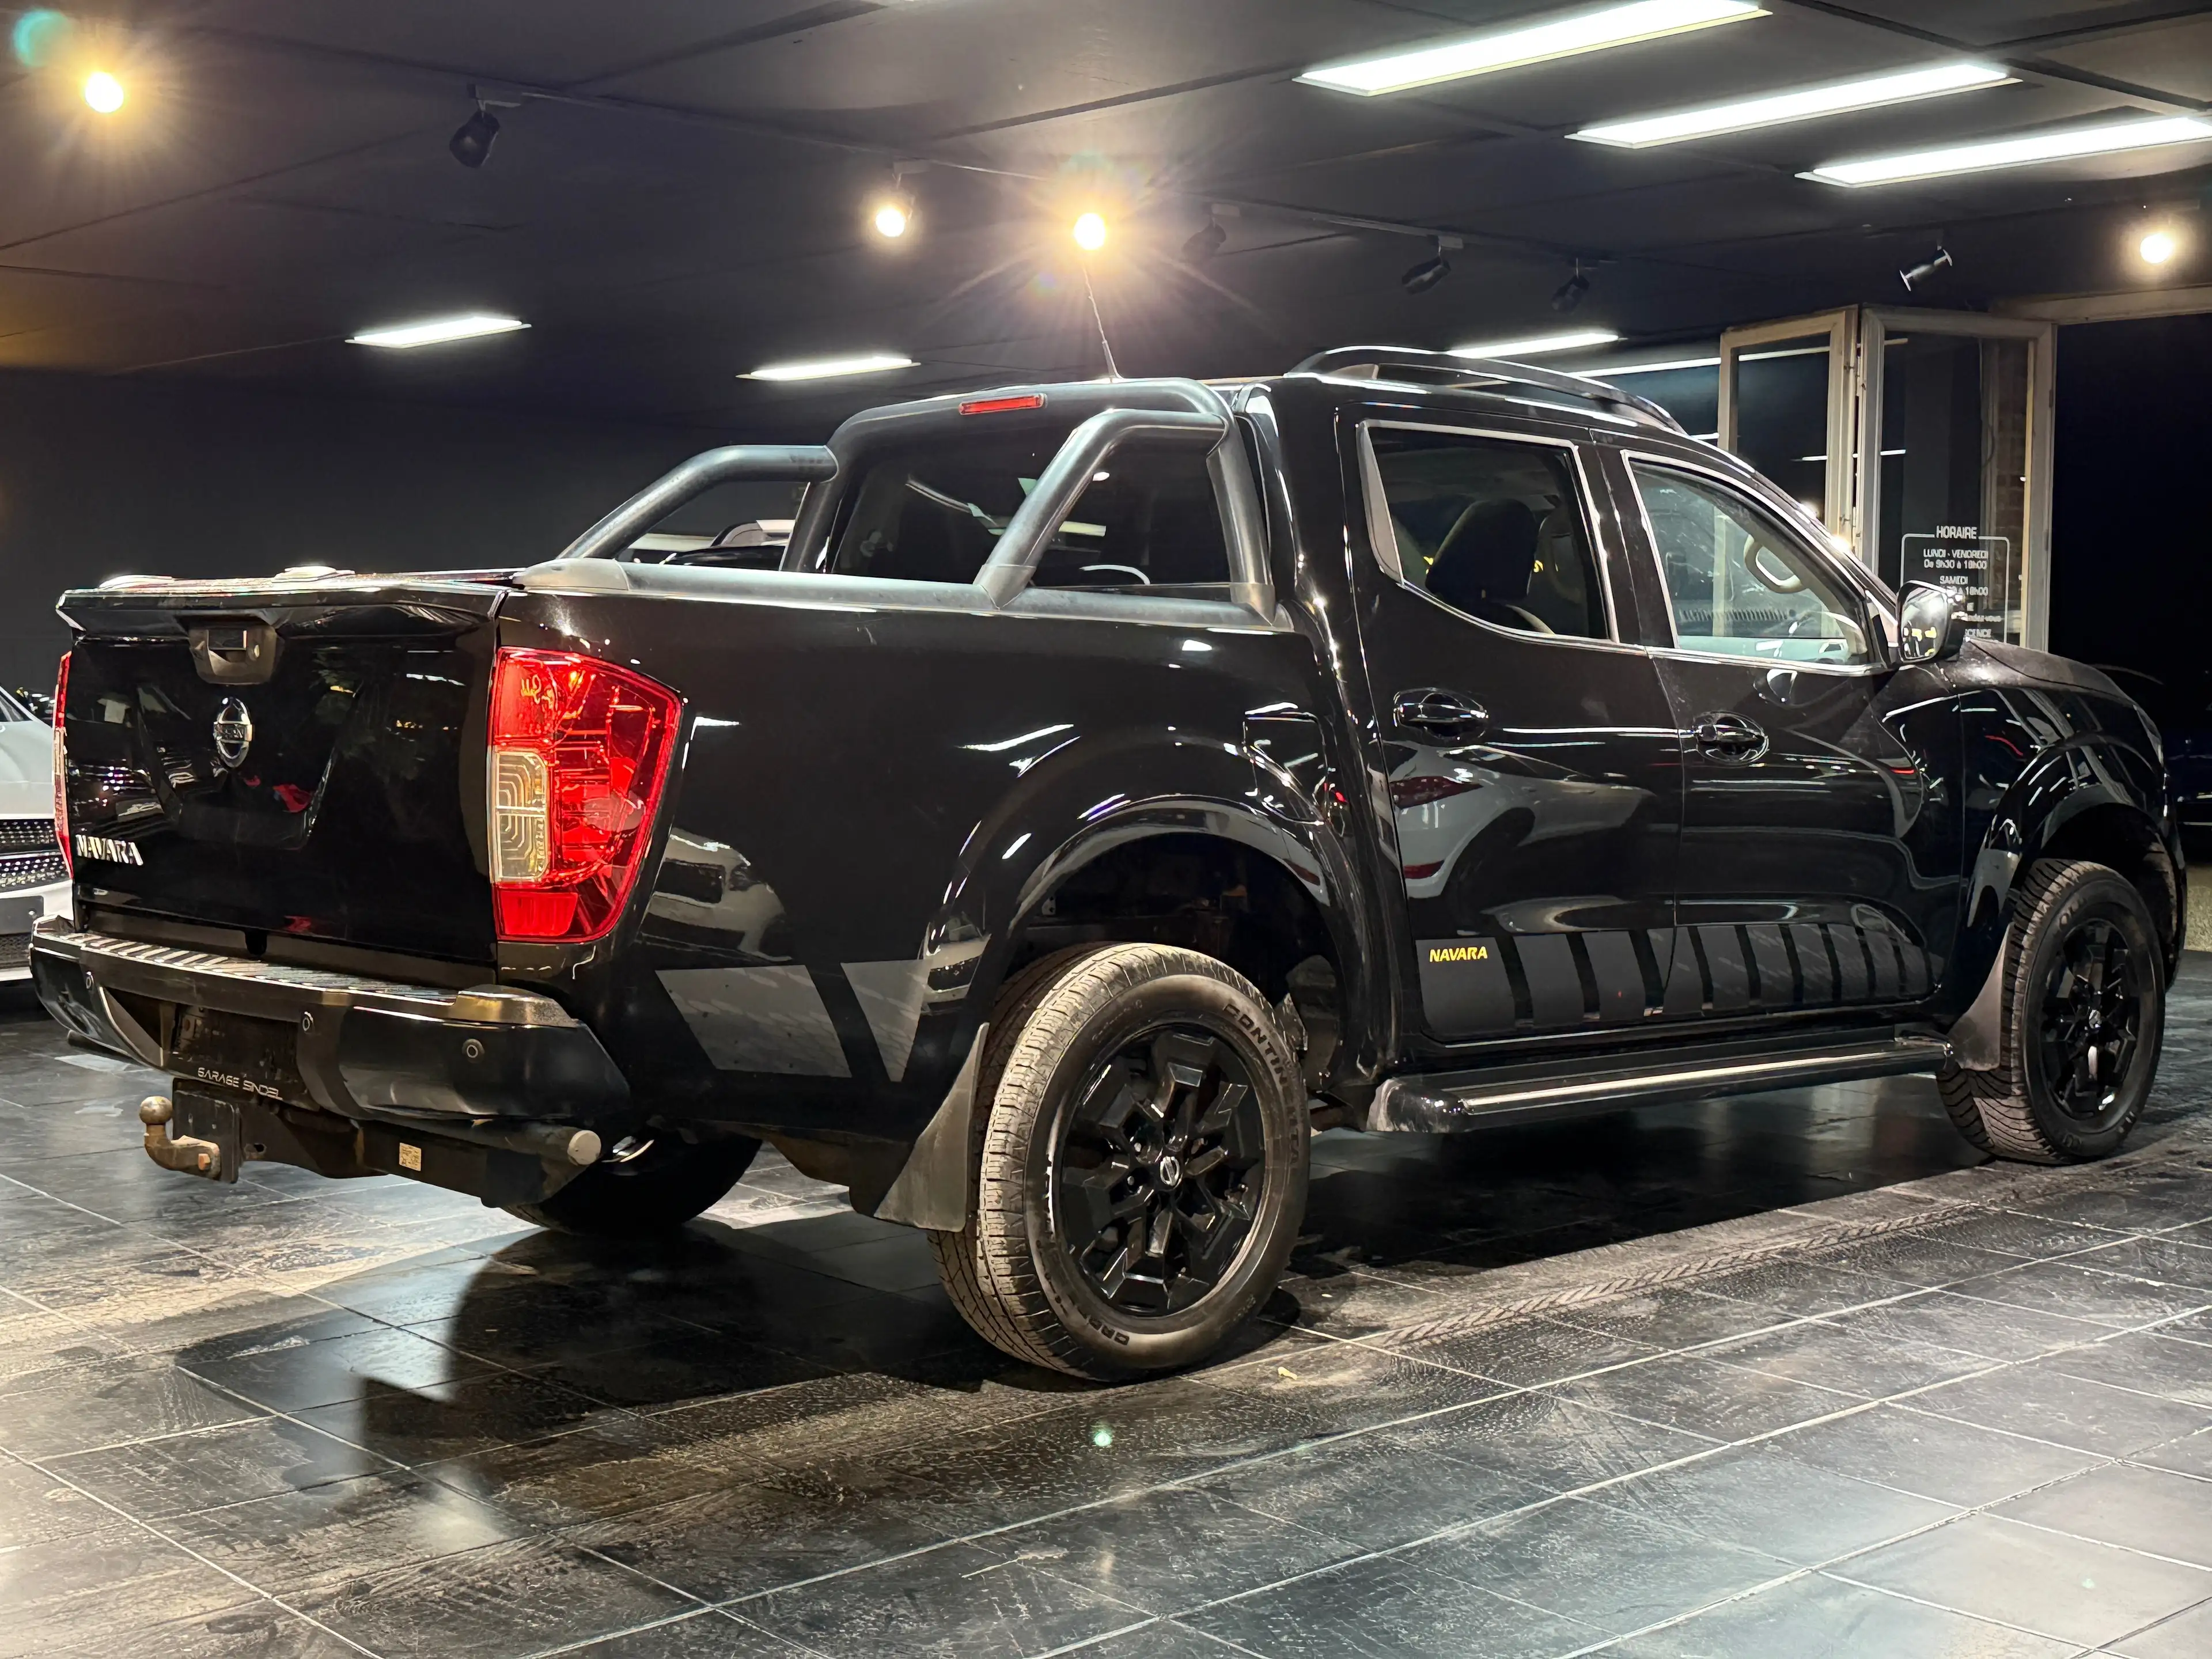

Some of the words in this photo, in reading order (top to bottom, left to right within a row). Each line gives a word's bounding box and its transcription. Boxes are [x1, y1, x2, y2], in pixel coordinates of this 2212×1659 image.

[1936, 525, 1978, 540] HORAIRE
[1923, 548, 1946, 558] LUNDI
[1952, 549, 1989, 559] VENDREDI
[1940, 575, 1968, 585] SAMEDI
[75, 834, 144, 866] NAVARA
[1429, 946, 1488, 963] NAVARA
[198, 1067, 240, 1088] GARAGE
